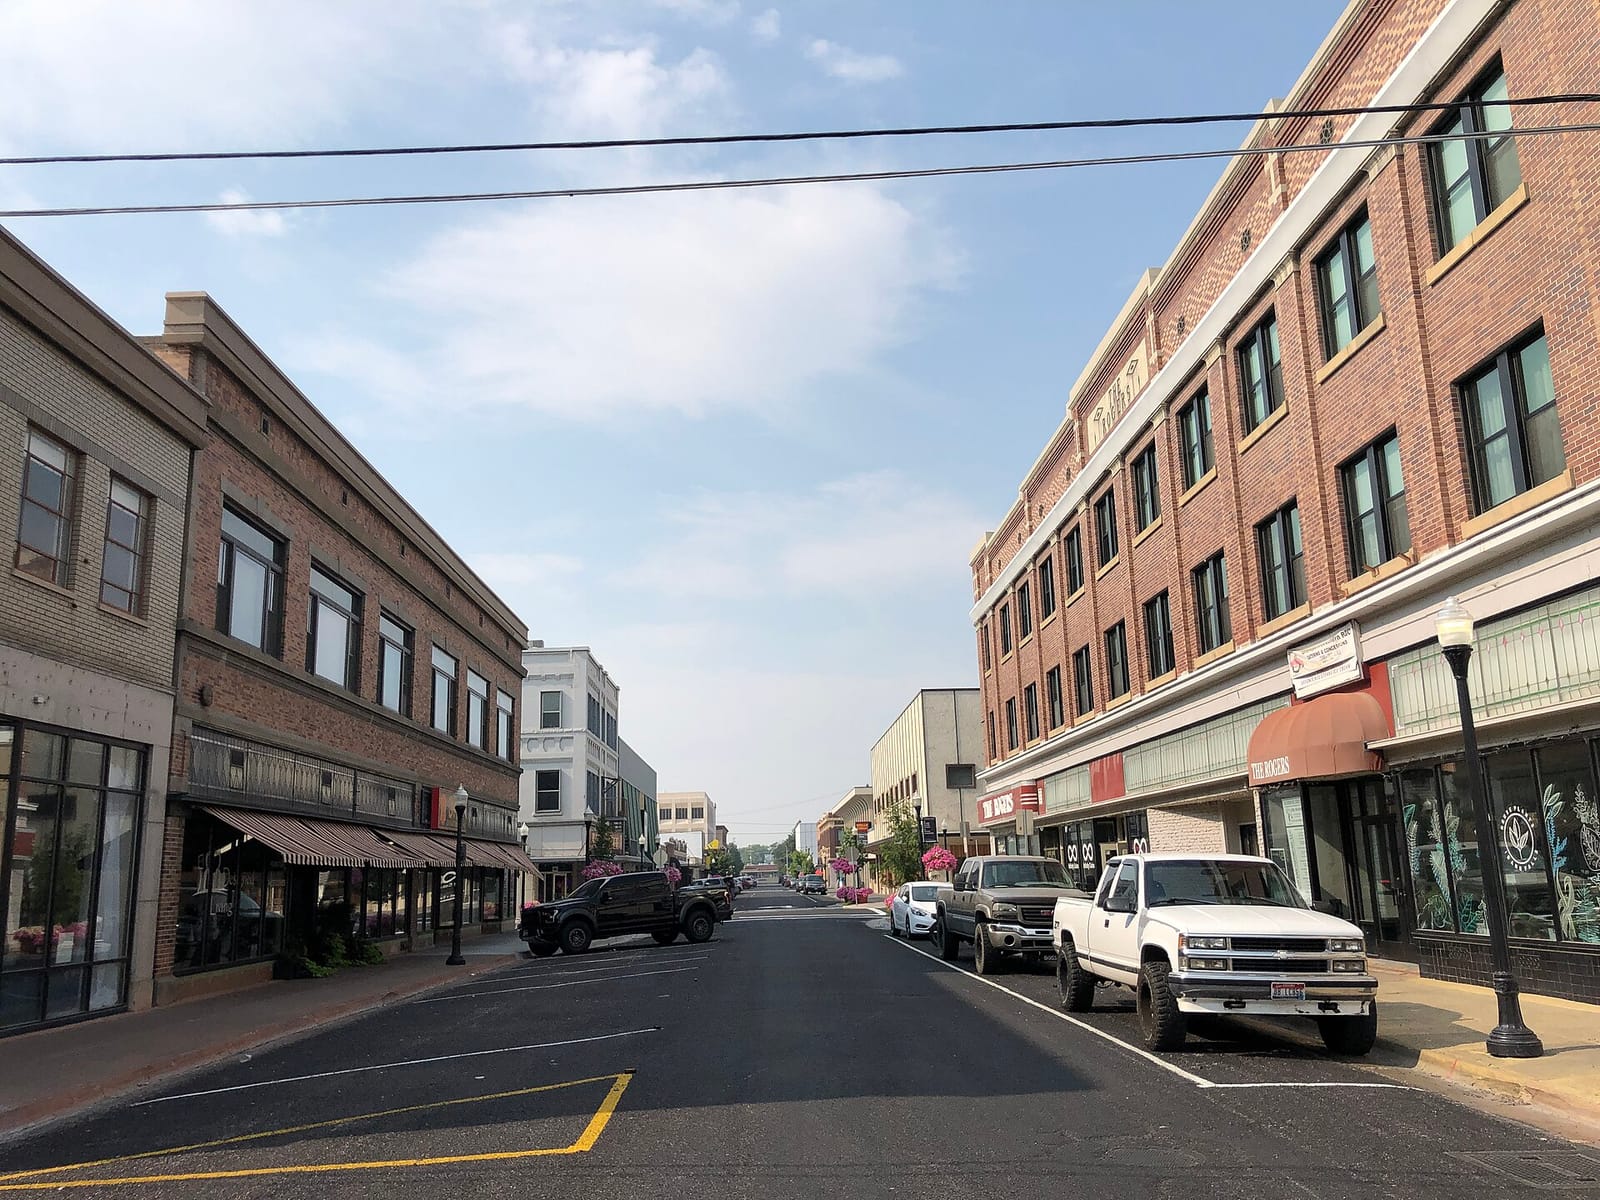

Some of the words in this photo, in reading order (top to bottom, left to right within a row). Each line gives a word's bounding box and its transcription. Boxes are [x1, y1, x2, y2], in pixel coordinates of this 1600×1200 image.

[1102, 384, 1131, 433] ROGERS
[1108, 378, 1121, 409] THE
[1251, 762, 1264, 780] THE
[1264, 756, 1290, 777] ROGERS
